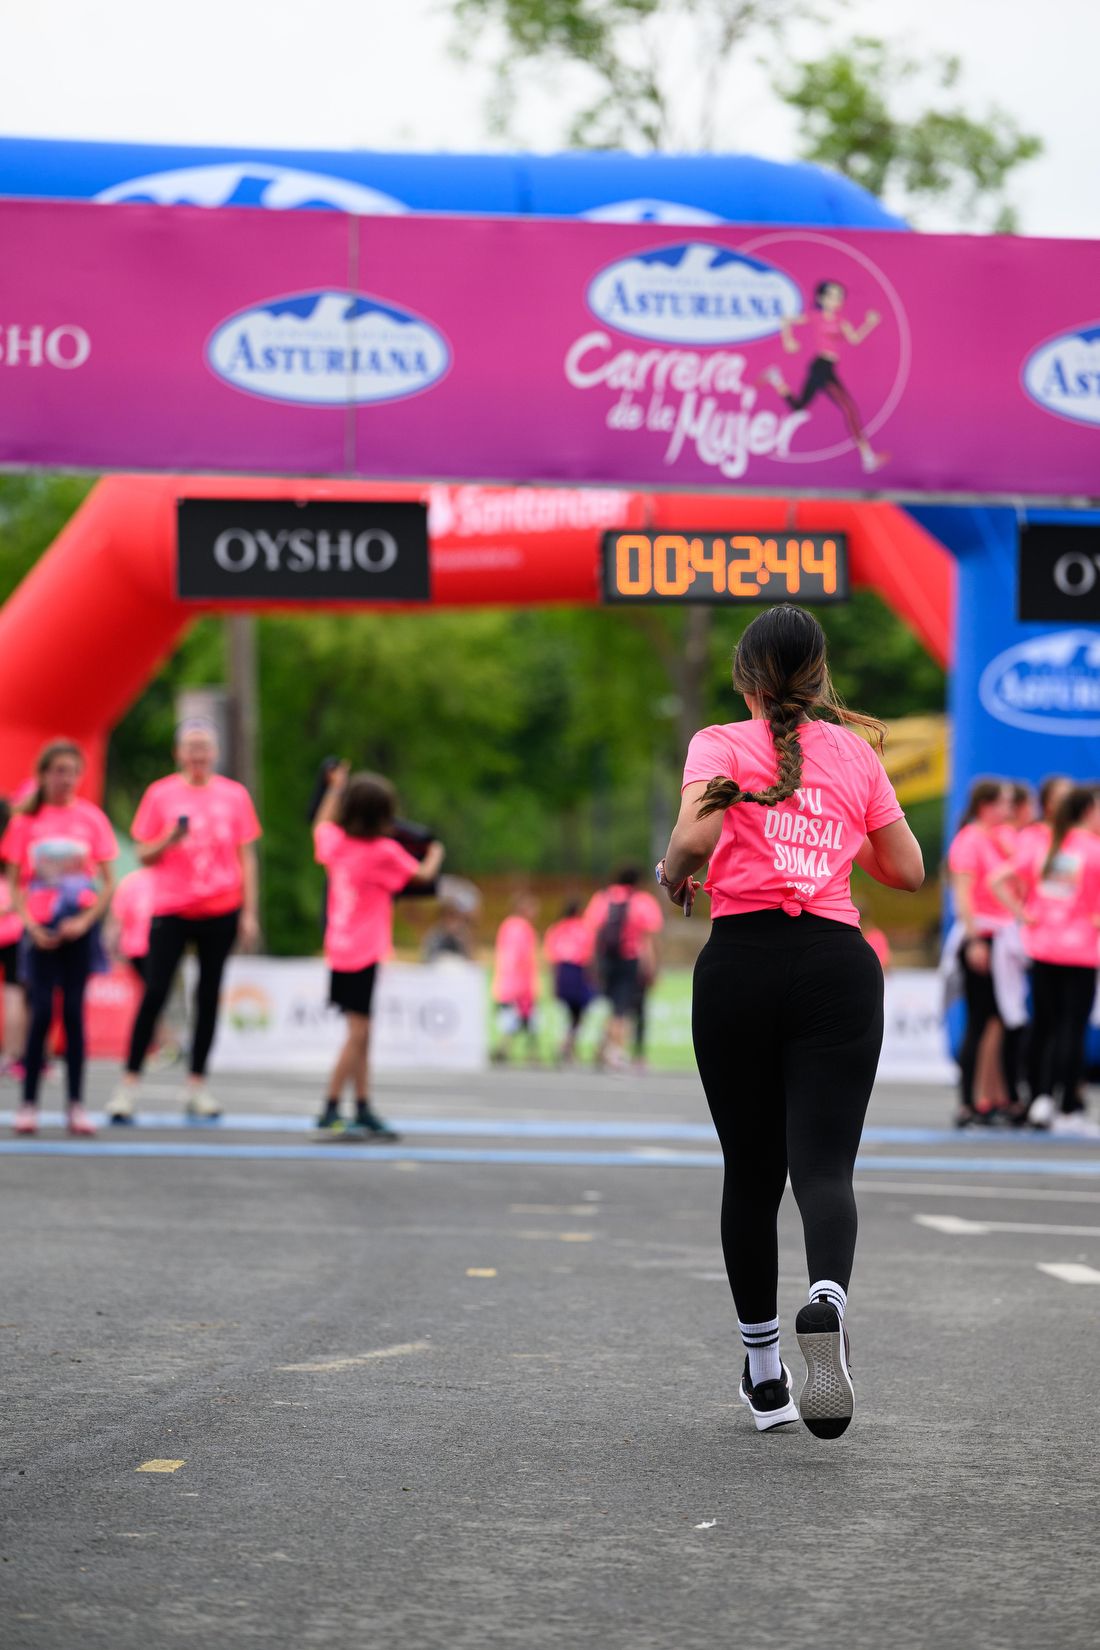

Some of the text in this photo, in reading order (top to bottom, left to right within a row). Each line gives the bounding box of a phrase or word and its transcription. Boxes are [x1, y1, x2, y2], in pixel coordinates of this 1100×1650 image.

[605, 279, 784, 318] ASTURIANA
[0, 323, 91, 370] HO
[224, 331, 428, 374] ASTURIANA
[564, 331, 747, 394] Carrera
[606, 391, 645, 431] de
[663, 387, 811, 479] Mujer
[213, 527, 398, 573] OYSHO
[1053, 551, 1100, 597] O
[794, 787, 822, 816] TU
[764, 809, 843, 850] DORSAL
[773, 842, 832, 878] SUMA
